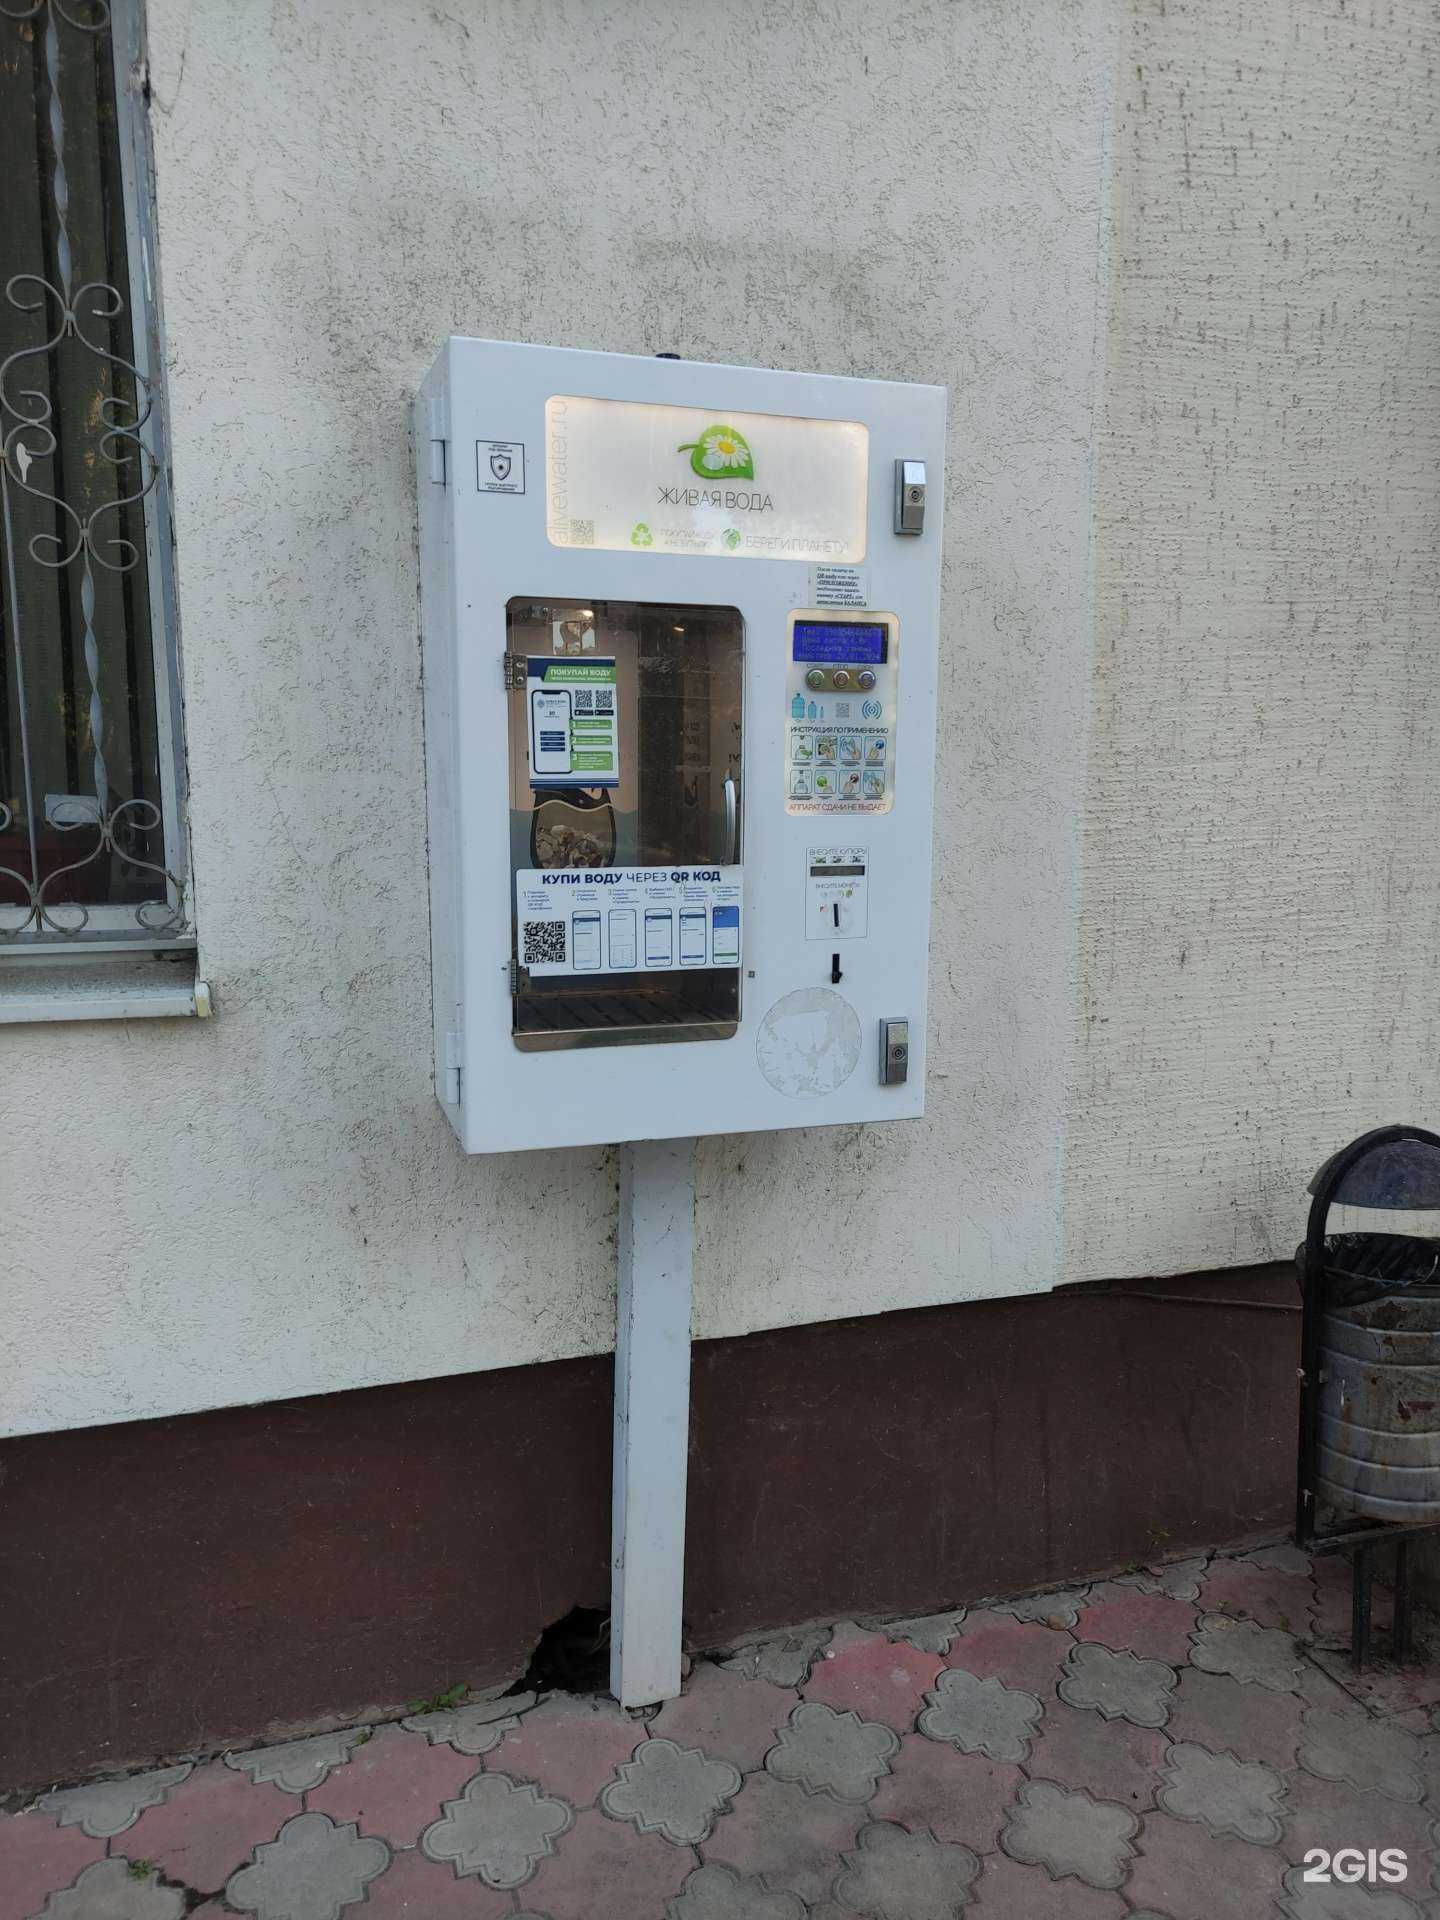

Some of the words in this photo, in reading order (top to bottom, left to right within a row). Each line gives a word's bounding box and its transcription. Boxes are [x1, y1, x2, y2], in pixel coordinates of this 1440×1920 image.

[657, 487, 721, 507] ЖИВАЯ
[725, 491, 774, 513] ВОДА
[550, 667, 589, 677] ПОКУПАЙ
[589, 669, 611, 677] ВОДУ
[542, 874, 580, 884] КУПИ
[585, 873, 623, 885] ВОДУ
[626, 872, 667, 882] ЧЕРЕЗ
[670, 872, 689, 883] QR
[693, 871, 721, 882] КОД
